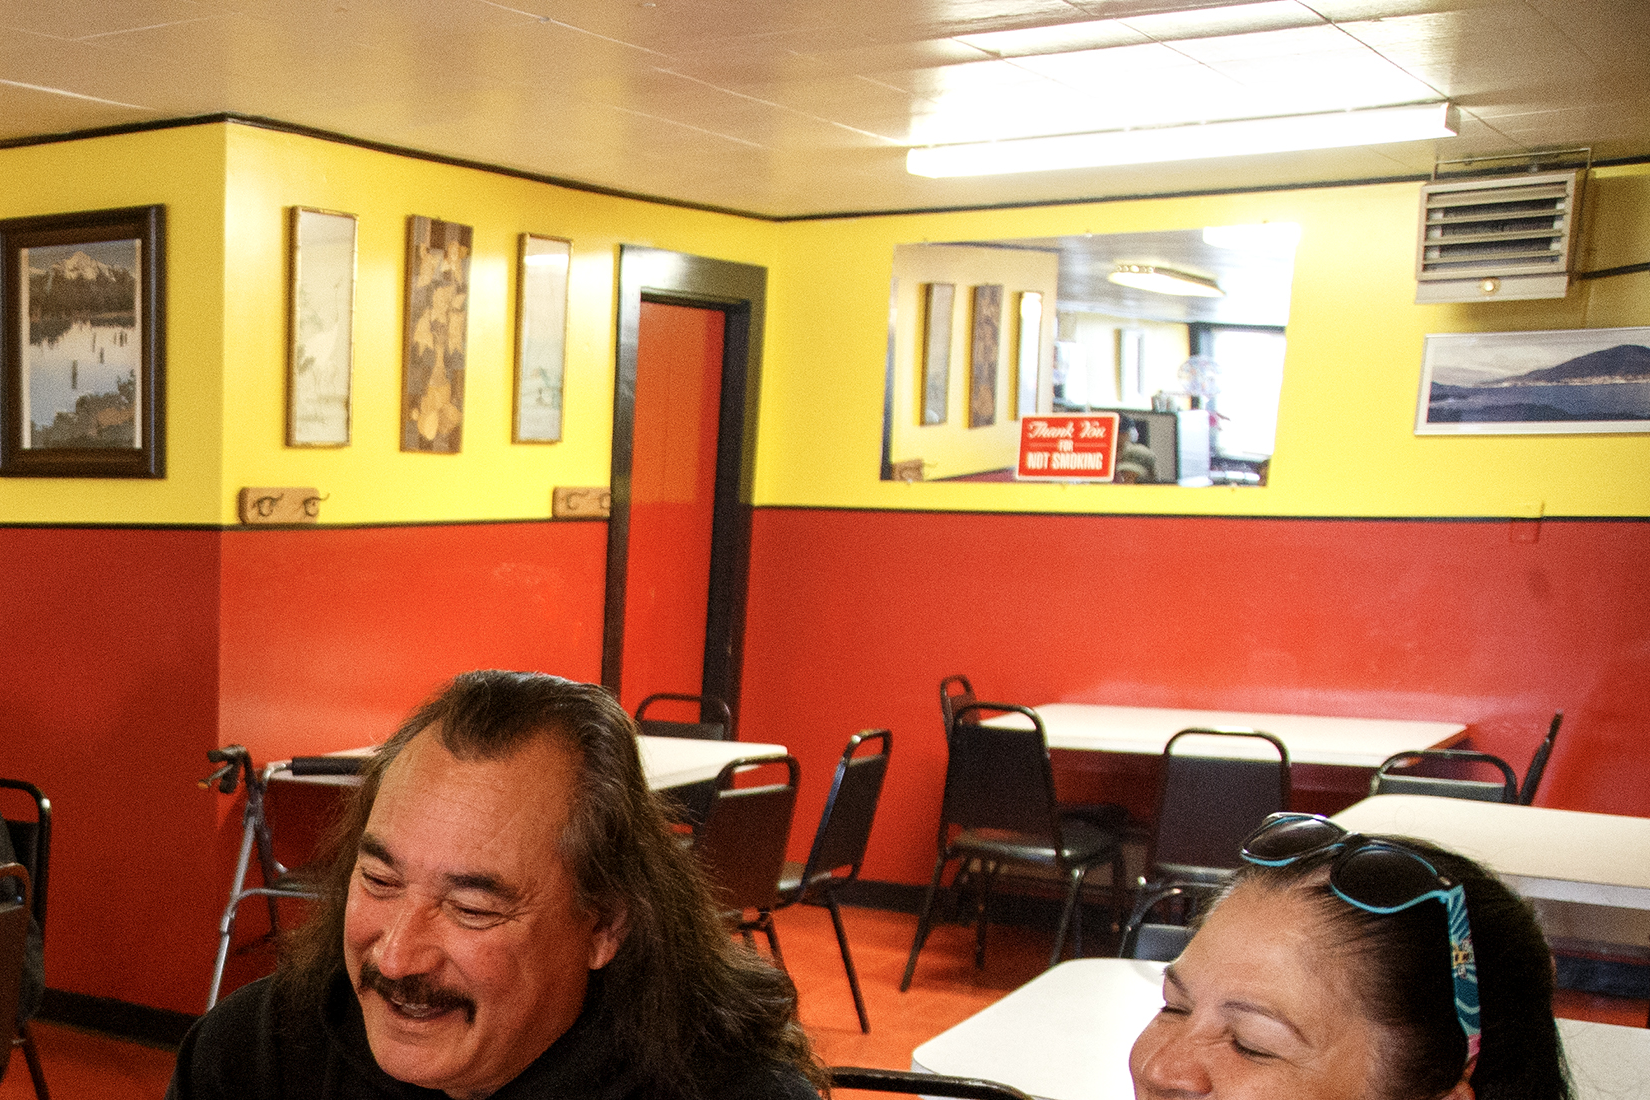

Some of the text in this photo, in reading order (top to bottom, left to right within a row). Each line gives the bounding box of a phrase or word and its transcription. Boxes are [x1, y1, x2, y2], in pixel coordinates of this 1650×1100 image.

[1028, 421, 1106, 439] Thank You
[1058, 439, 1073, 451] FOR
[1027, 452, 1103, 470] NOT SMOKING
